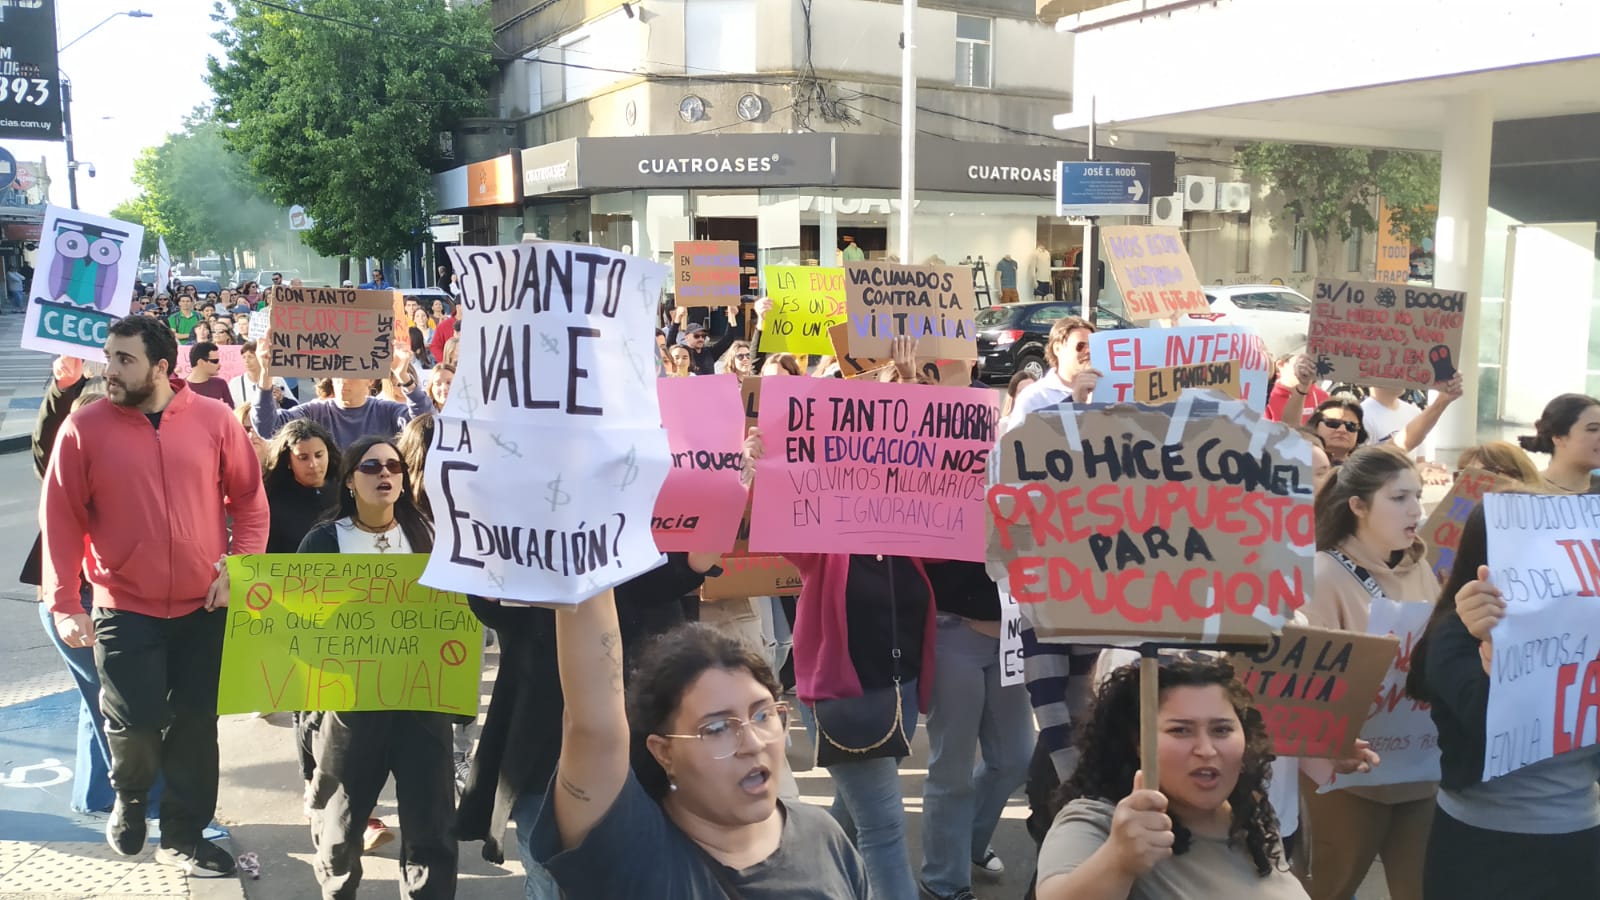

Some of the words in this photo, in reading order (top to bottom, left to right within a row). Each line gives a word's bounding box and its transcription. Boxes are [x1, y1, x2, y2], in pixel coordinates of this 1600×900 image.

[1083, 166, 1104, 177] JOSÉ
[1105, 168, 1114, 177] E.
[1115, 166, 1137, 177] RODÓ
[680, 255, 690, 266] EN
[1382, 246, 1408, 259] TODO
[681, 270, 691, 282] ES
[777, 272, 797, 290] LA
[849, 267, 954, 292] VACUNADOS
[1377, 269, 1409, 282] TRAPO
[275, 286, 304, 304] CON
[306, 289, 357, 305] TANTO
[779, 296, 800, 314] ES
[809, 299, 825, 314] UN
[862, 287, 932, 308] CONTRA
[939, 293, 962, 310] LA
[1315, 281, 1365, 304] 31/10
[273, 306, 372, 335] RECORTE
[1315, 303, 1344, 320] EL
[273, 331, 291, 349] NI
[296, 331, 342, 350] MARX
[370, 313, 393, 361] CLASE
[771, 319, 794, 336] NO
[802, 321, 822, 337] UN
[271, 349, 358, 372] ENTIENDE
[360, 357, 380, 371] LA
[1106, 337, 1158, 372] EL
[1164, 332, 1269, 372] INTERIOR
[1388, 348, 1398, 366] Y
[480, 323, 604, 416] VALE
[1149, 371, 1168, 401] EL
[1172, 361, 1232, 392] FANTASMA
[788, 396, 816, 432] DE
[919, 401, 1000, 443] AHORRAR
[436, 418, 472, 454] LA
[786, 436, 816, 464] EN
[824, 428, 937, 469] EDUCACIÓN
[941, 448, 989, 474] NOS
[788, 466, 882, 496] VOLVIMOS
[1014, 439, 1074, 483] LO
[1196, 437, 1272, 492] CON
[1272, 463, 1313, 496] EL
[440, 460, 626, 577] EDUCACIÓN?
[793, 497, 821, 527] EN
[834, 495, 965, 532] IGNORANCIA
[986, 480, 1316, 550] PRESUPUESTO
[1088, 525, 1216, 572] PARA
[240, 554, 260, 583] SI
[270, 562, 399, 578] EMPEZAMOS
[1006, 551, 1306, 624] EDUCACIÓN
[1528, 567, 1573, 601] DEL
[230, 610, 275, 639] POR
[285, 606, 326, 631] QUÉ
[336, 611, 376, 631] NOS
[288, 636, 301, 656] A
[1313, 640, 1354, 673] LA
[1573, 633, 1589, 663] A
[260, 658, 461, 711] VIRTUAL
